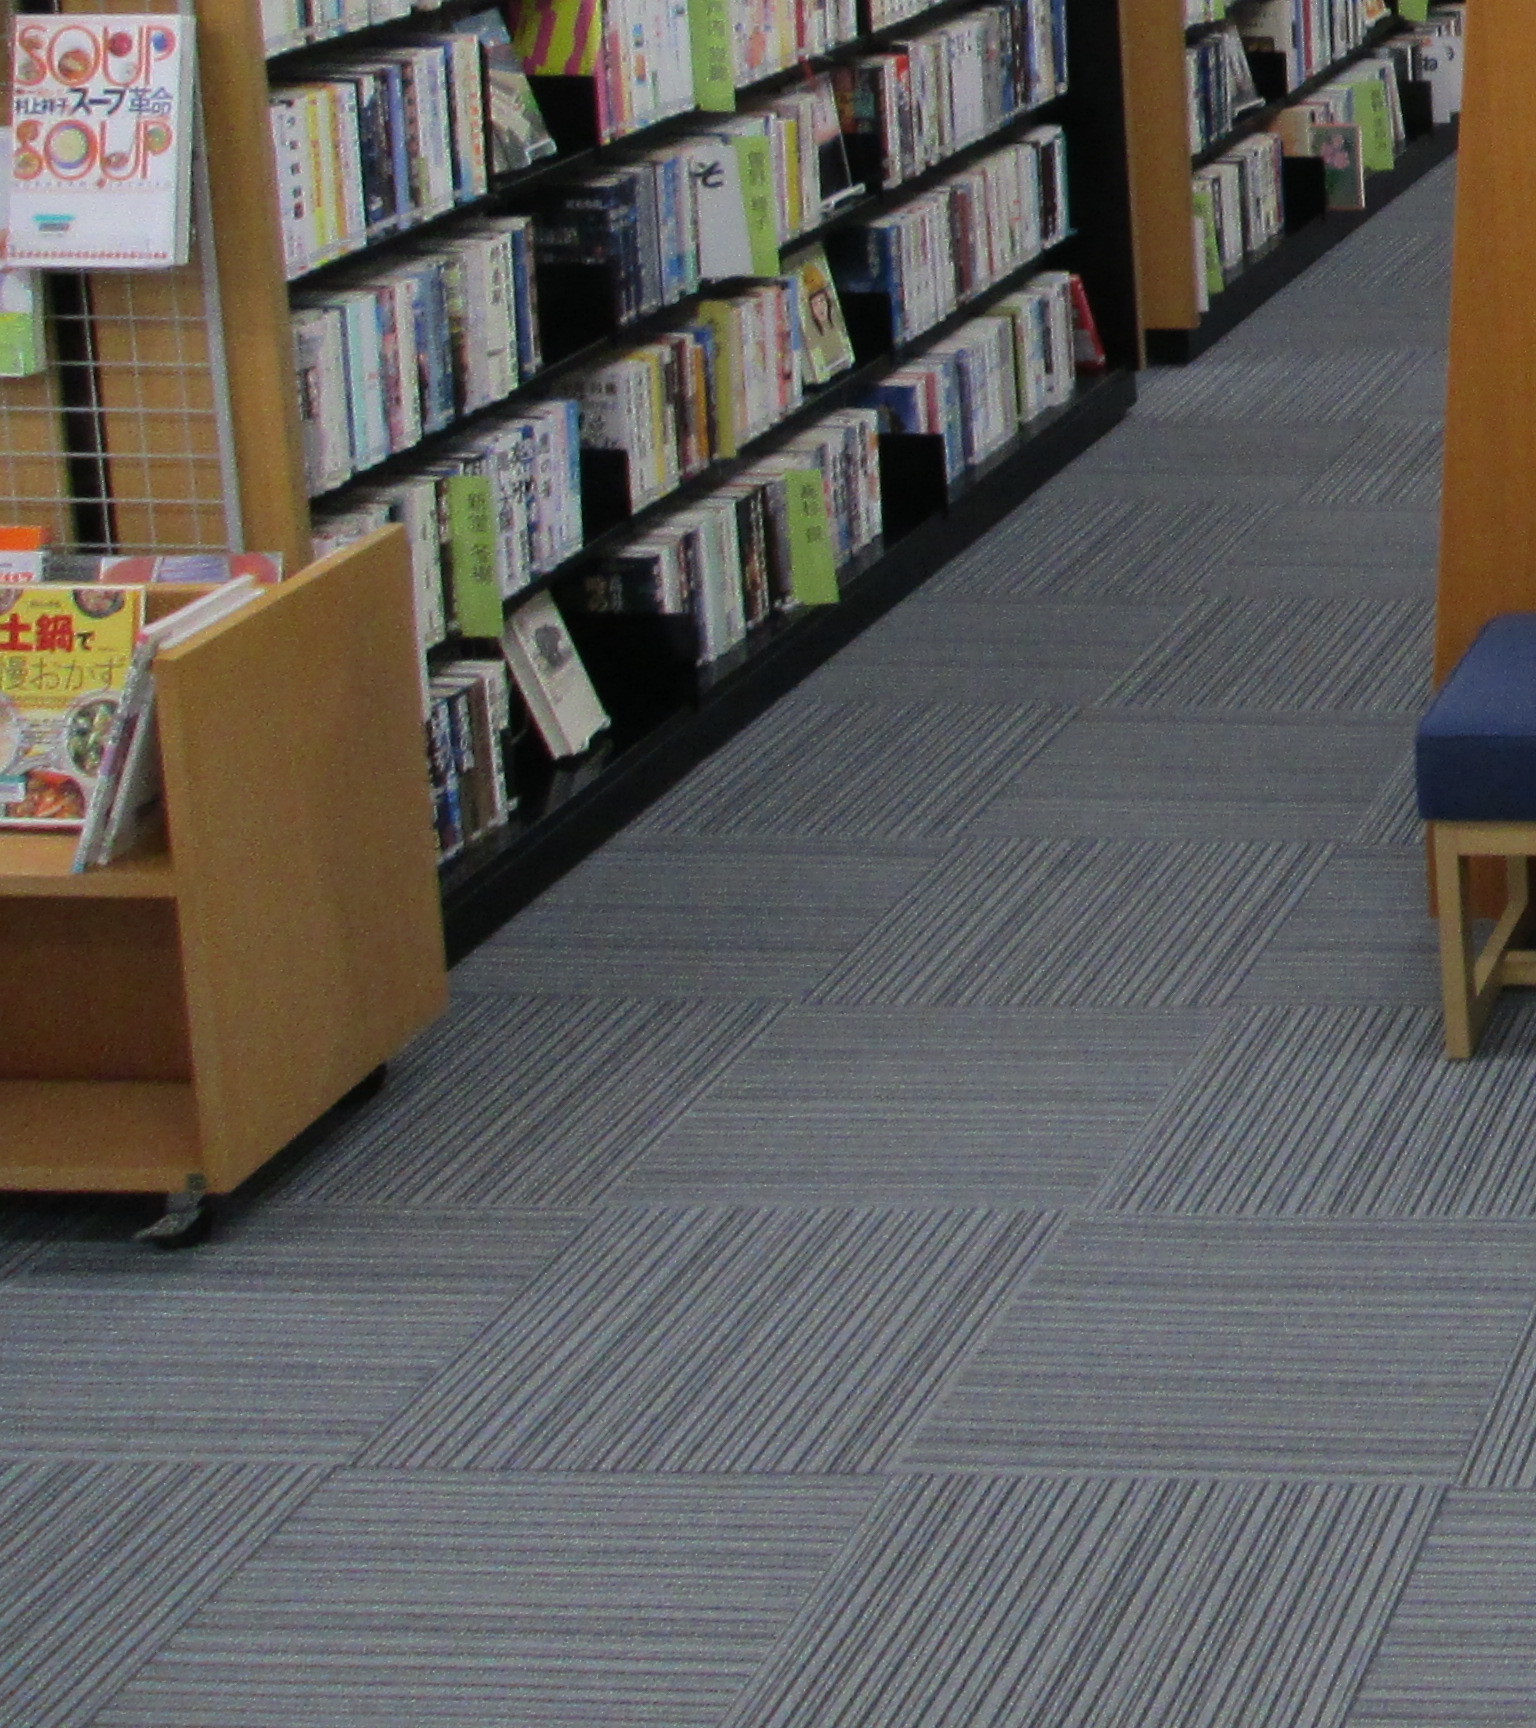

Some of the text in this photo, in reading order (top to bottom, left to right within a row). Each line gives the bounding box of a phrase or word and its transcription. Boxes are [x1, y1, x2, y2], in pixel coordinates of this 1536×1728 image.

[14, 24, 177, 86] SOUP
[66, 87, 174, 116] スープ革命
[12, 118, 174, 181] SOUP
